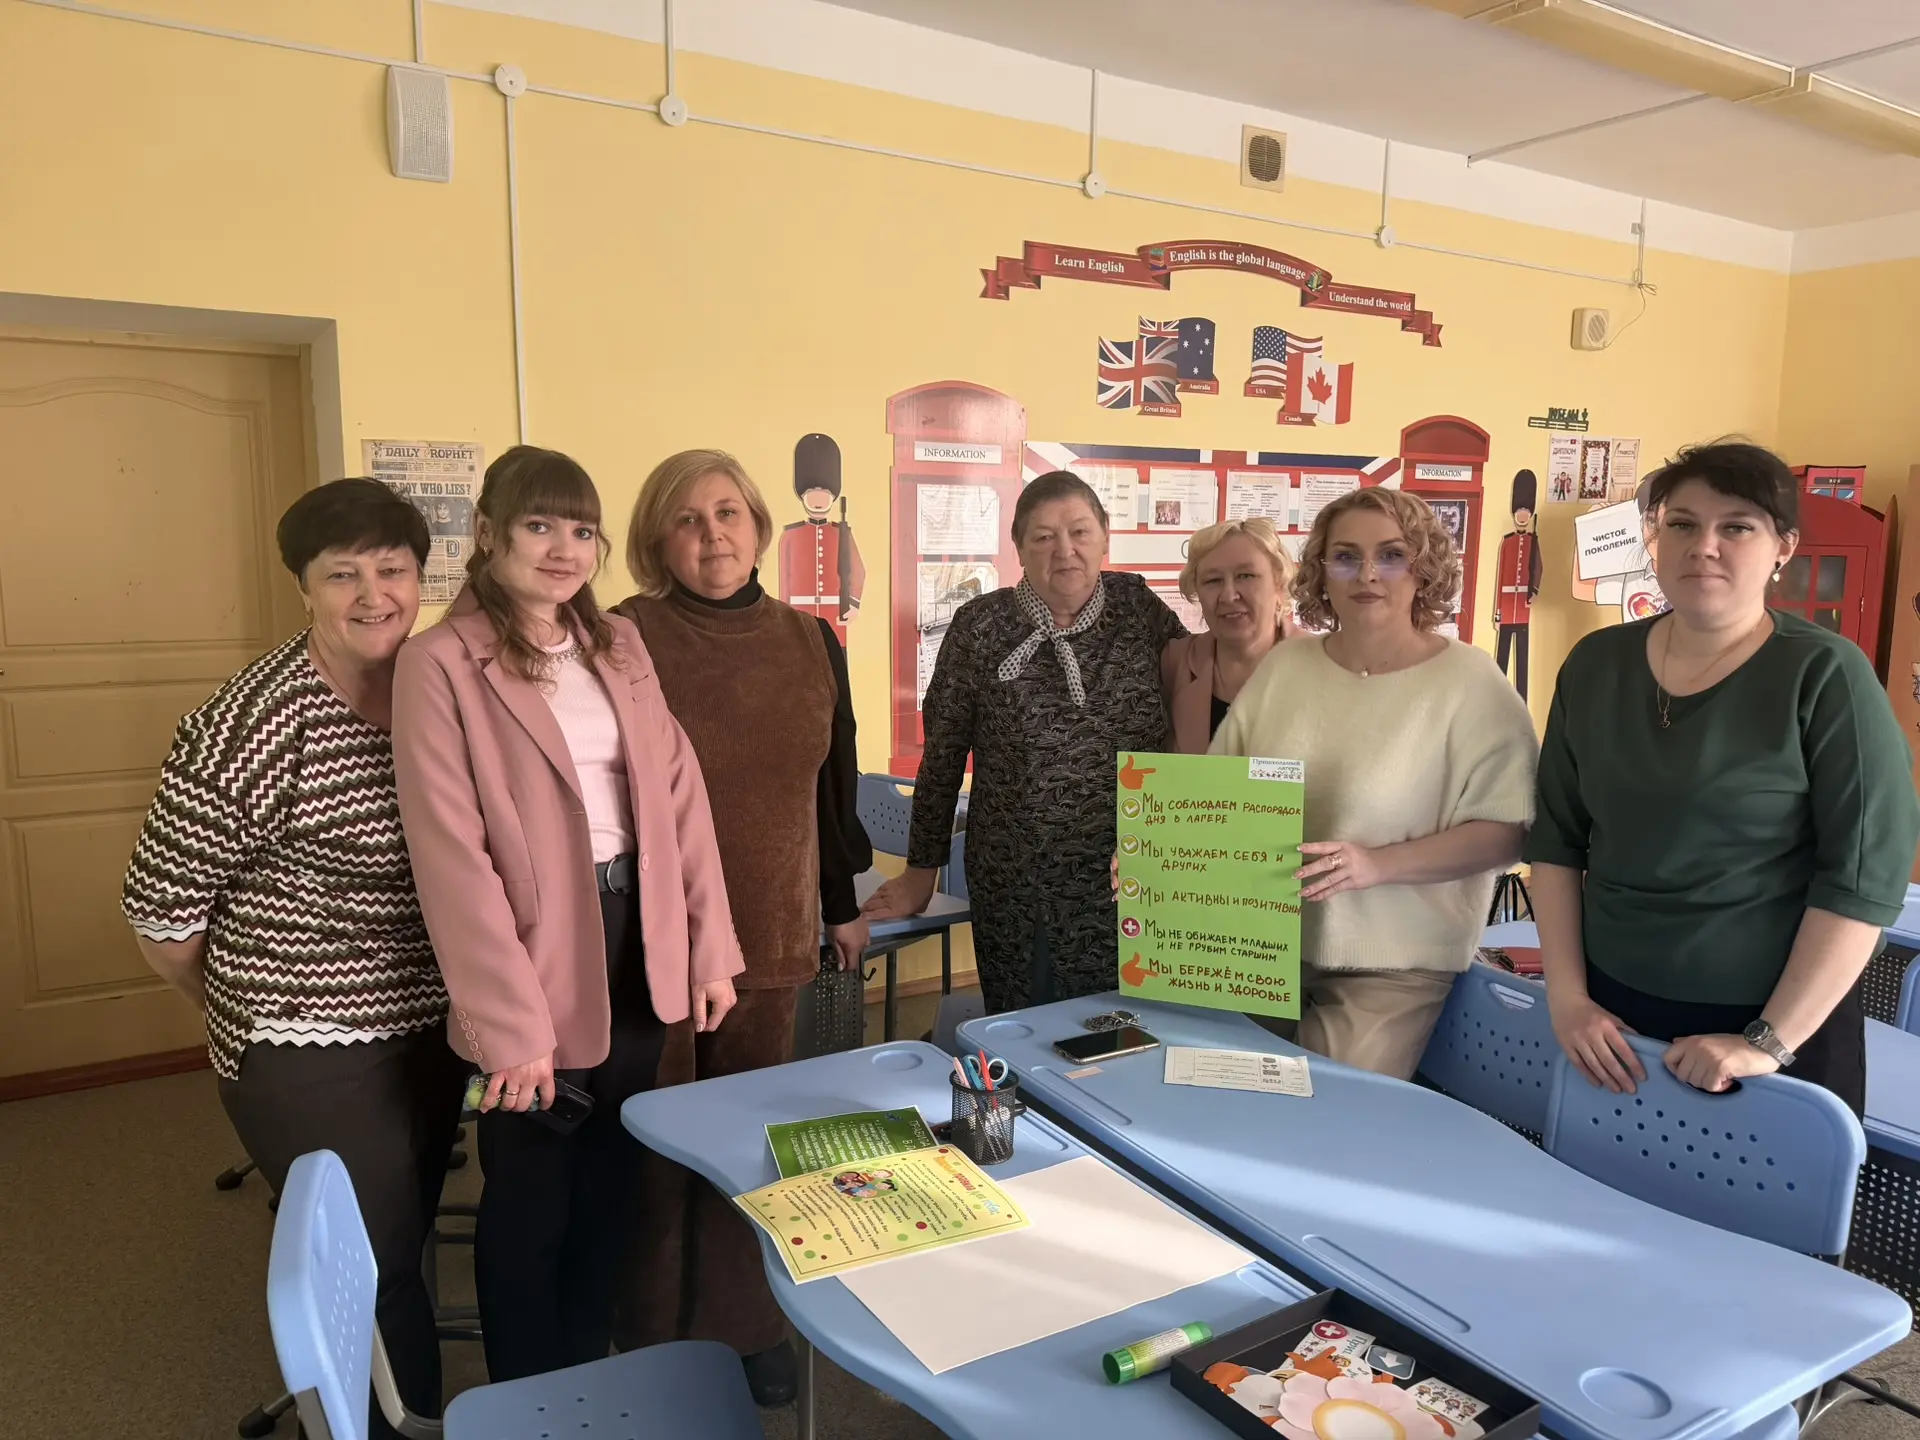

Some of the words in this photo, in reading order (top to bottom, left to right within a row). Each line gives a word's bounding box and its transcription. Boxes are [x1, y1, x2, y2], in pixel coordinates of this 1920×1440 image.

[1054, 254, 1084, 270] Learn
[1088, 259, 1124, 274] English
[1169, 250, 1206, 262] English
[1209, 250, 1216, 261] is
[1219, 250, 1235, 262] the
[1236, 251, 1265, 268] global
[1266, 256, 1306, 280] language
[1329, 291, 1374, 308] Understand
[1375, 298, 1389, 309] the
[1390, 299, 1411, 311] world
[1189, 382, 1211, 391] Australia
[1144, 405, 1158, 413] Great
[1160, 406, 1176, 414] Britain
[385, 448, 420, 457] DAILY
[924, 448, 986, 459] INFORMATION
[1421, 469, 1462, 477] INFORMATION
[420, 483, 442, 494] WHO
[1593, 529, 1627, 543] ЧИСТОЕ
[1585, 537, 1638, 556] ПОКОЛЕНИЕ
[1168, 800, 1236, 811] СОБЛЮДАЕМ
[1243, 803, 1301, 816] РАСПОРЯДОК
[1145, 815, 1166, 826] ДНЯ
[1174, 815, 1180, 823] В
[1187, 814, 1228, 824] ЛАГЕРЕ
[1171, 847, 1228, 859] УВАЖАЕМ
[1234, 851, 1267, 862] СЕБЯ
[1276, 854, 1283, 862] И
[1162, 860, 1206, 872] ДРУГИХ
[1172, 892, 1229, 905] АКТИВНЫ
[1242, 897, 1301, 916] ПОЗИТИВНЫ
[1169, 929, 1182, 939] НЕ
[1186, 931, 1236, 944] ОБИЖАЕМ
[1241, 937, 1288, 952] МЛАДШИХ
[1157, 942, 1163, 950] И
[1170, 942, 1183, 950] НЕ
[1189, 942, 1226, 955] ГРУБИМ
[1231, 948, 1277, 962] СТАРШИМ
[1247, 974, 1286, 986] СВОЮ
[1168, 978, 1209, 993] ЖИЗНЬ
[1214, 984, 1222, 993] И
[1227, 984, 1291, 1002] ЗДОРОВЬЕ
